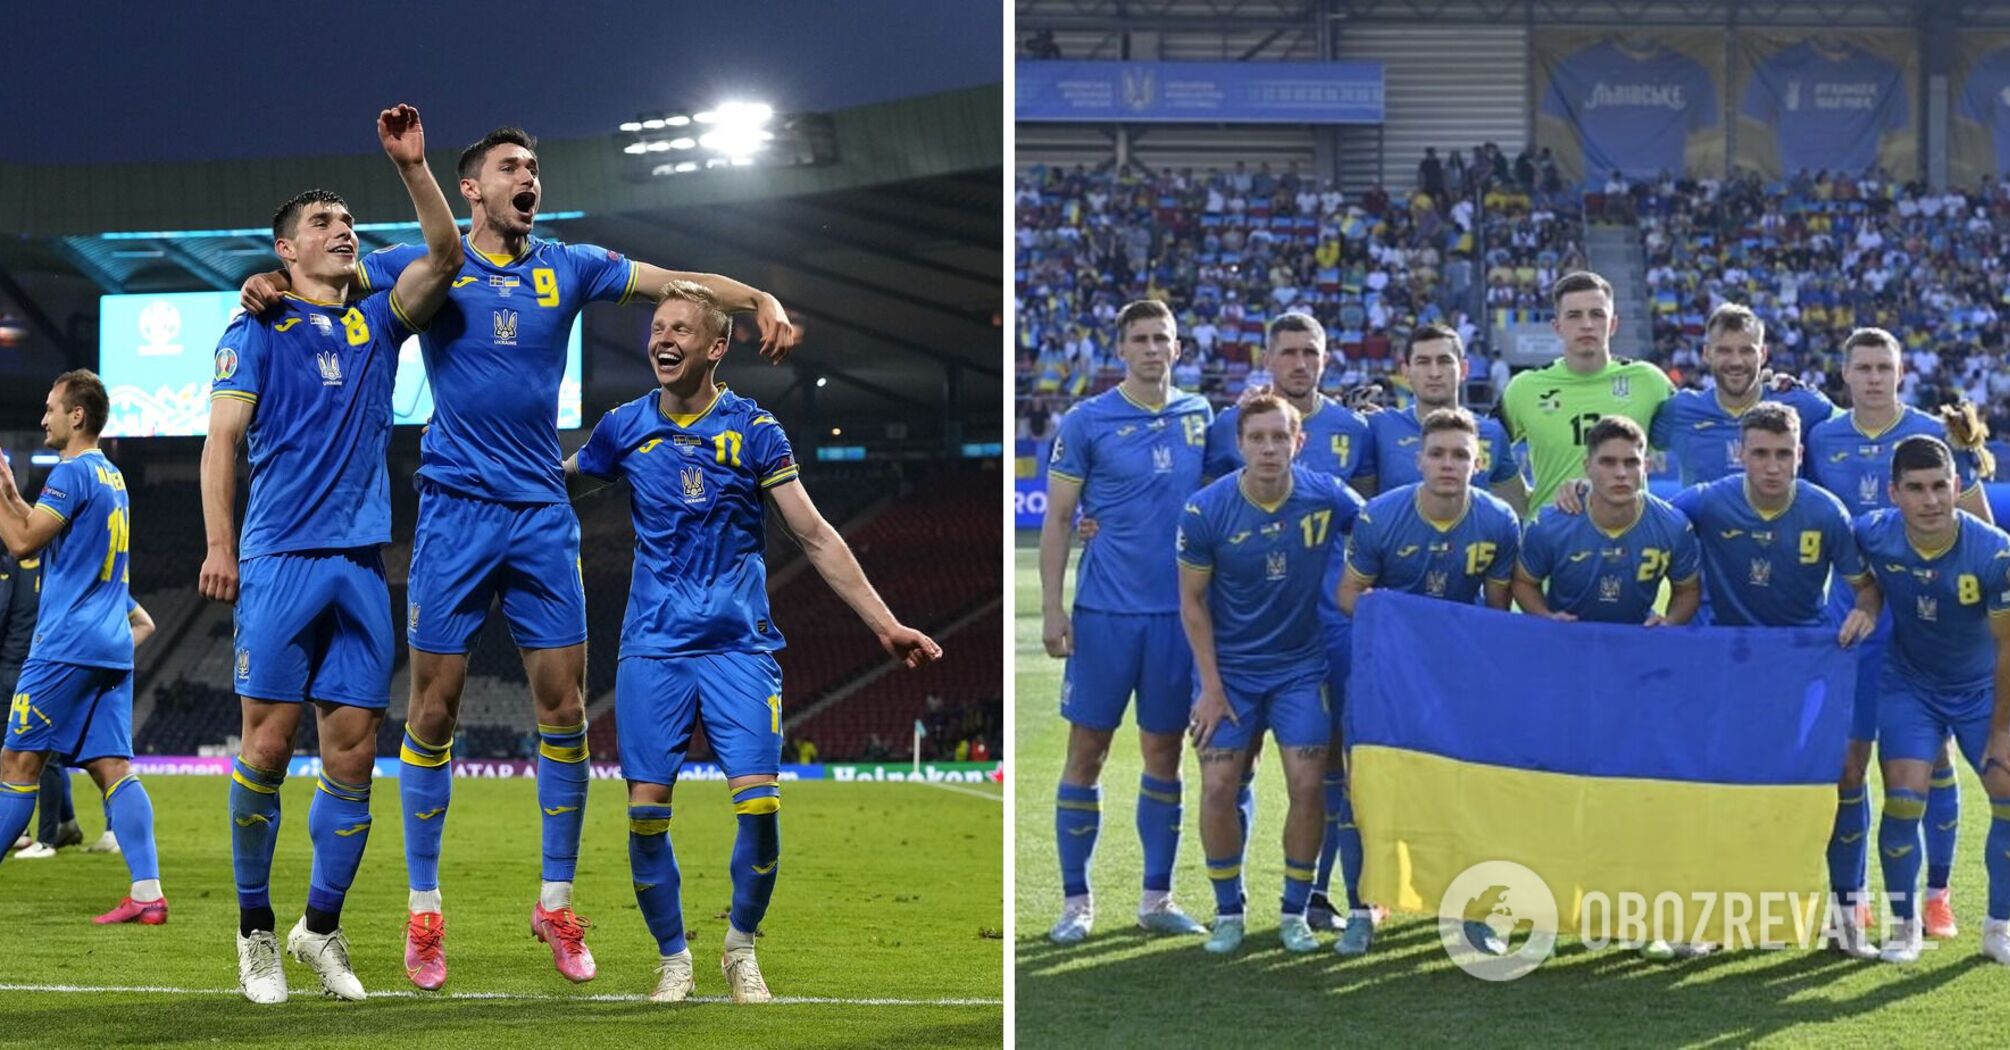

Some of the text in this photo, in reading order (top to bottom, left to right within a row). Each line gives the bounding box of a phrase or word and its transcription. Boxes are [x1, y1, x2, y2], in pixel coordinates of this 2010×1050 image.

[532, 268, 560, 307] 9
[340, 307, 370, 346] 8
[1331, 434, 1350, 468] 4
[1301, 510, 1332, 548] 17
[1465, 541, 1498, 575] 15
[1799, 531, 1821, 564] 9
[1957, 574, 1981, 605] 8
[832, 766, 992, 782] Heineken
